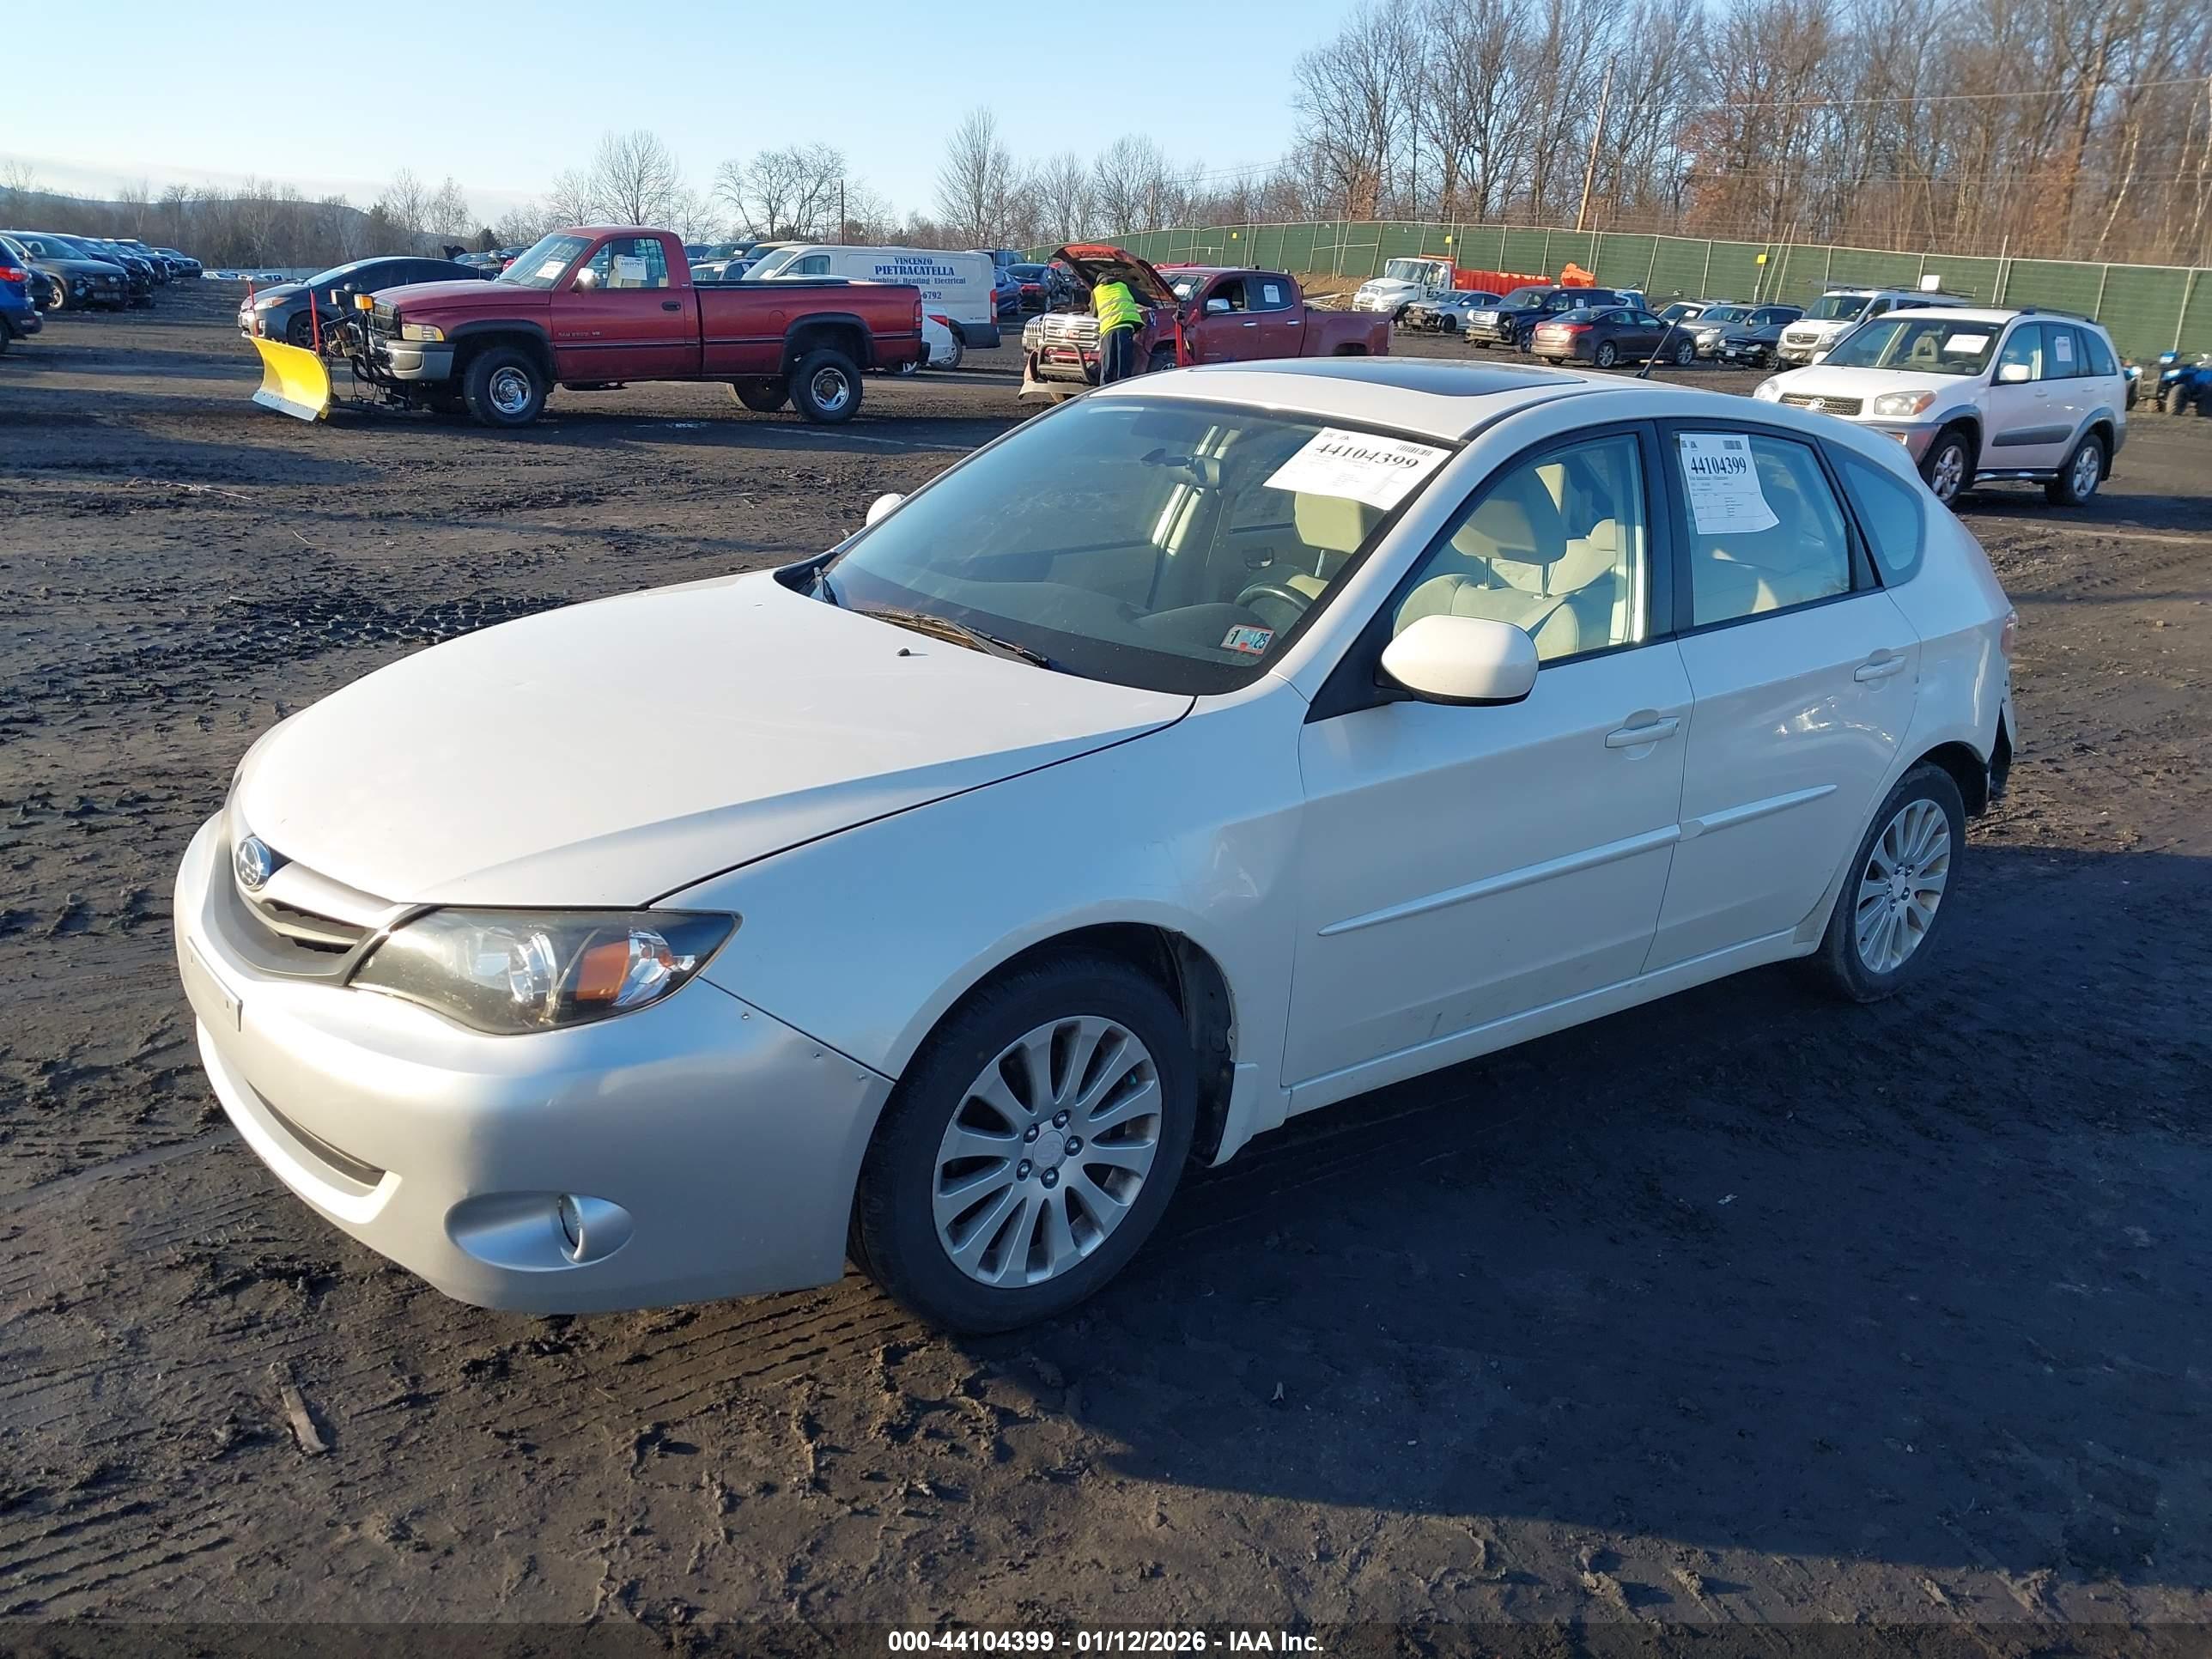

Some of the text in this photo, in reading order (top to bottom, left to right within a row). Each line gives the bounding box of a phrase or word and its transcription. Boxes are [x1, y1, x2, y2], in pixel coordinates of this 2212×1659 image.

[894, 257, 933, 265] VINCENZO
[875, 265, 955, 276] PIETRACATELLA
[1316, 443, 1419, 469] 44104399
[1691, 456, 1747, 474] 44104399
